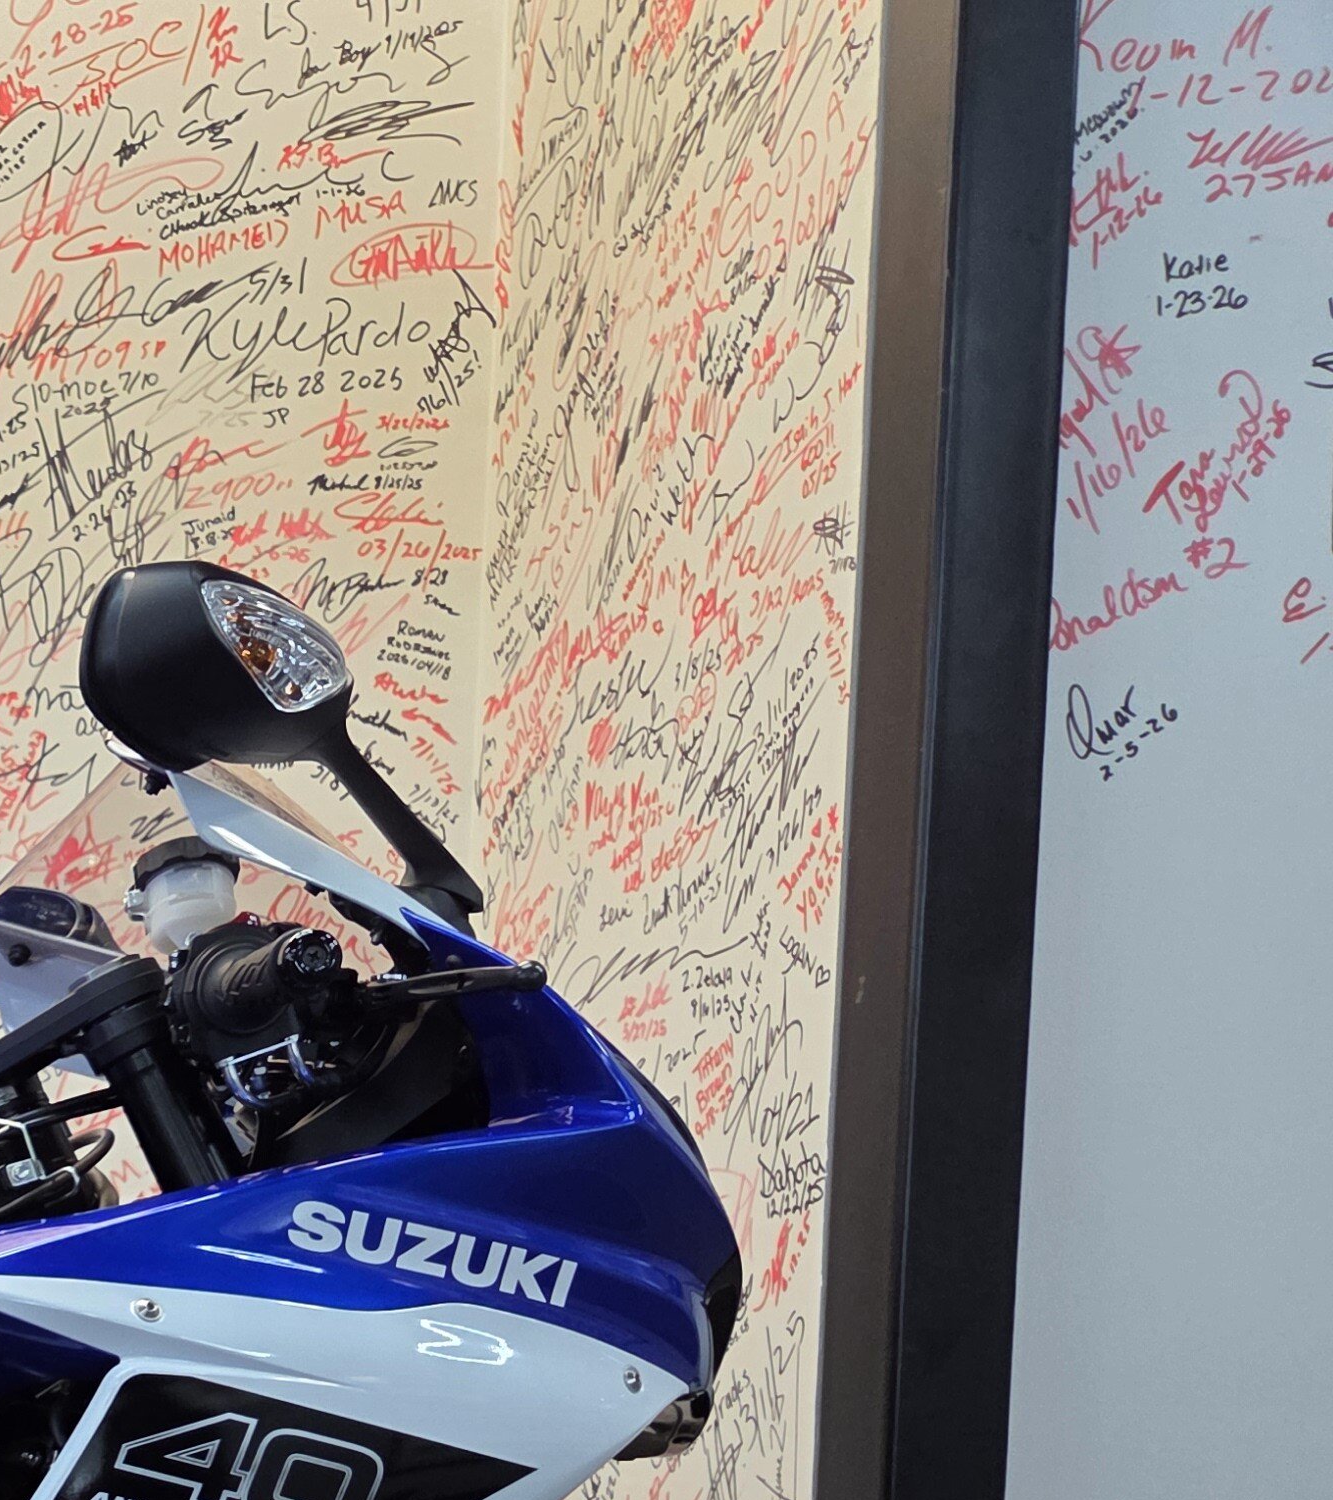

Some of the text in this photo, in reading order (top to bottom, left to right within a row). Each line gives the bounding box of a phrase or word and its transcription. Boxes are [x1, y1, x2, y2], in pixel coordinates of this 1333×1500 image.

[158, 218, 290, 277] MOHAMED
[1163, 251, 1231, 283] Katie
[1156, 284, 1249, 319] 1-23-26
[180, 292, 309, 382] Kyle
[250, 366, 403, 404] Feb 28 2025
[262, 406, 290, 429] JP
[180, 506, 237, 537] Junaid
[757, 1140, 827, 1199] Dakota
[288, 1201, 577, 1308] SUZUKI
